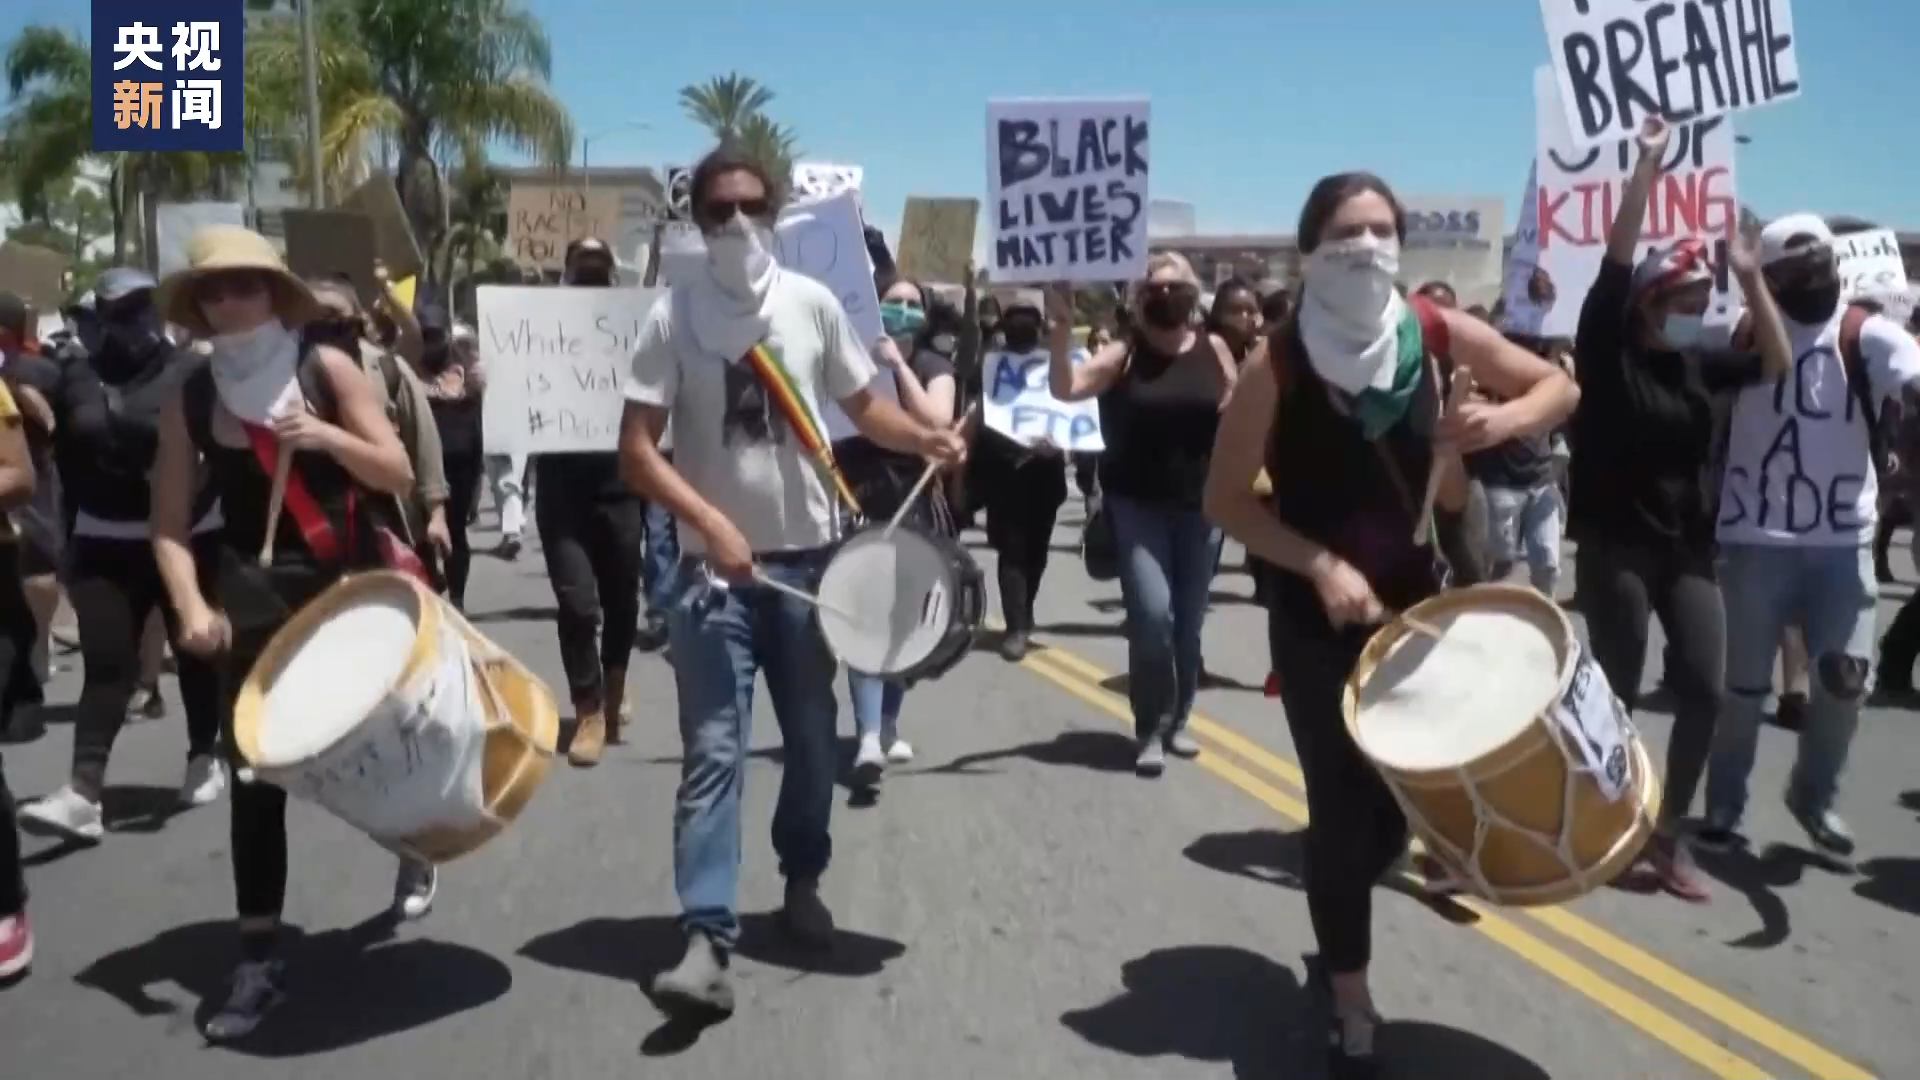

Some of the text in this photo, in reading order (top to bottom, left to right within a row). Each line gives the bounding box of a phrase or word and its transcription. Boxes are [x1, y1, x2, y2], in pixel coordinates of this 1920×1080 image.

[1563, 0, 1799, 137] BREATHE
[997, 114, 1148, 190] BLACK
[1000, 180, 1141, 231] LIVES
[1538, 166, 1735, 249] KILING
[996, 216, 1134, 269] MATTER
[486, 312, 583, 356] White
[525, 373, 552, 392] is
[1012, 405, 1098, 448] FTP
[1761, 415, 1805, 481] A
[1720, 466, 1867, 534] SIDE
